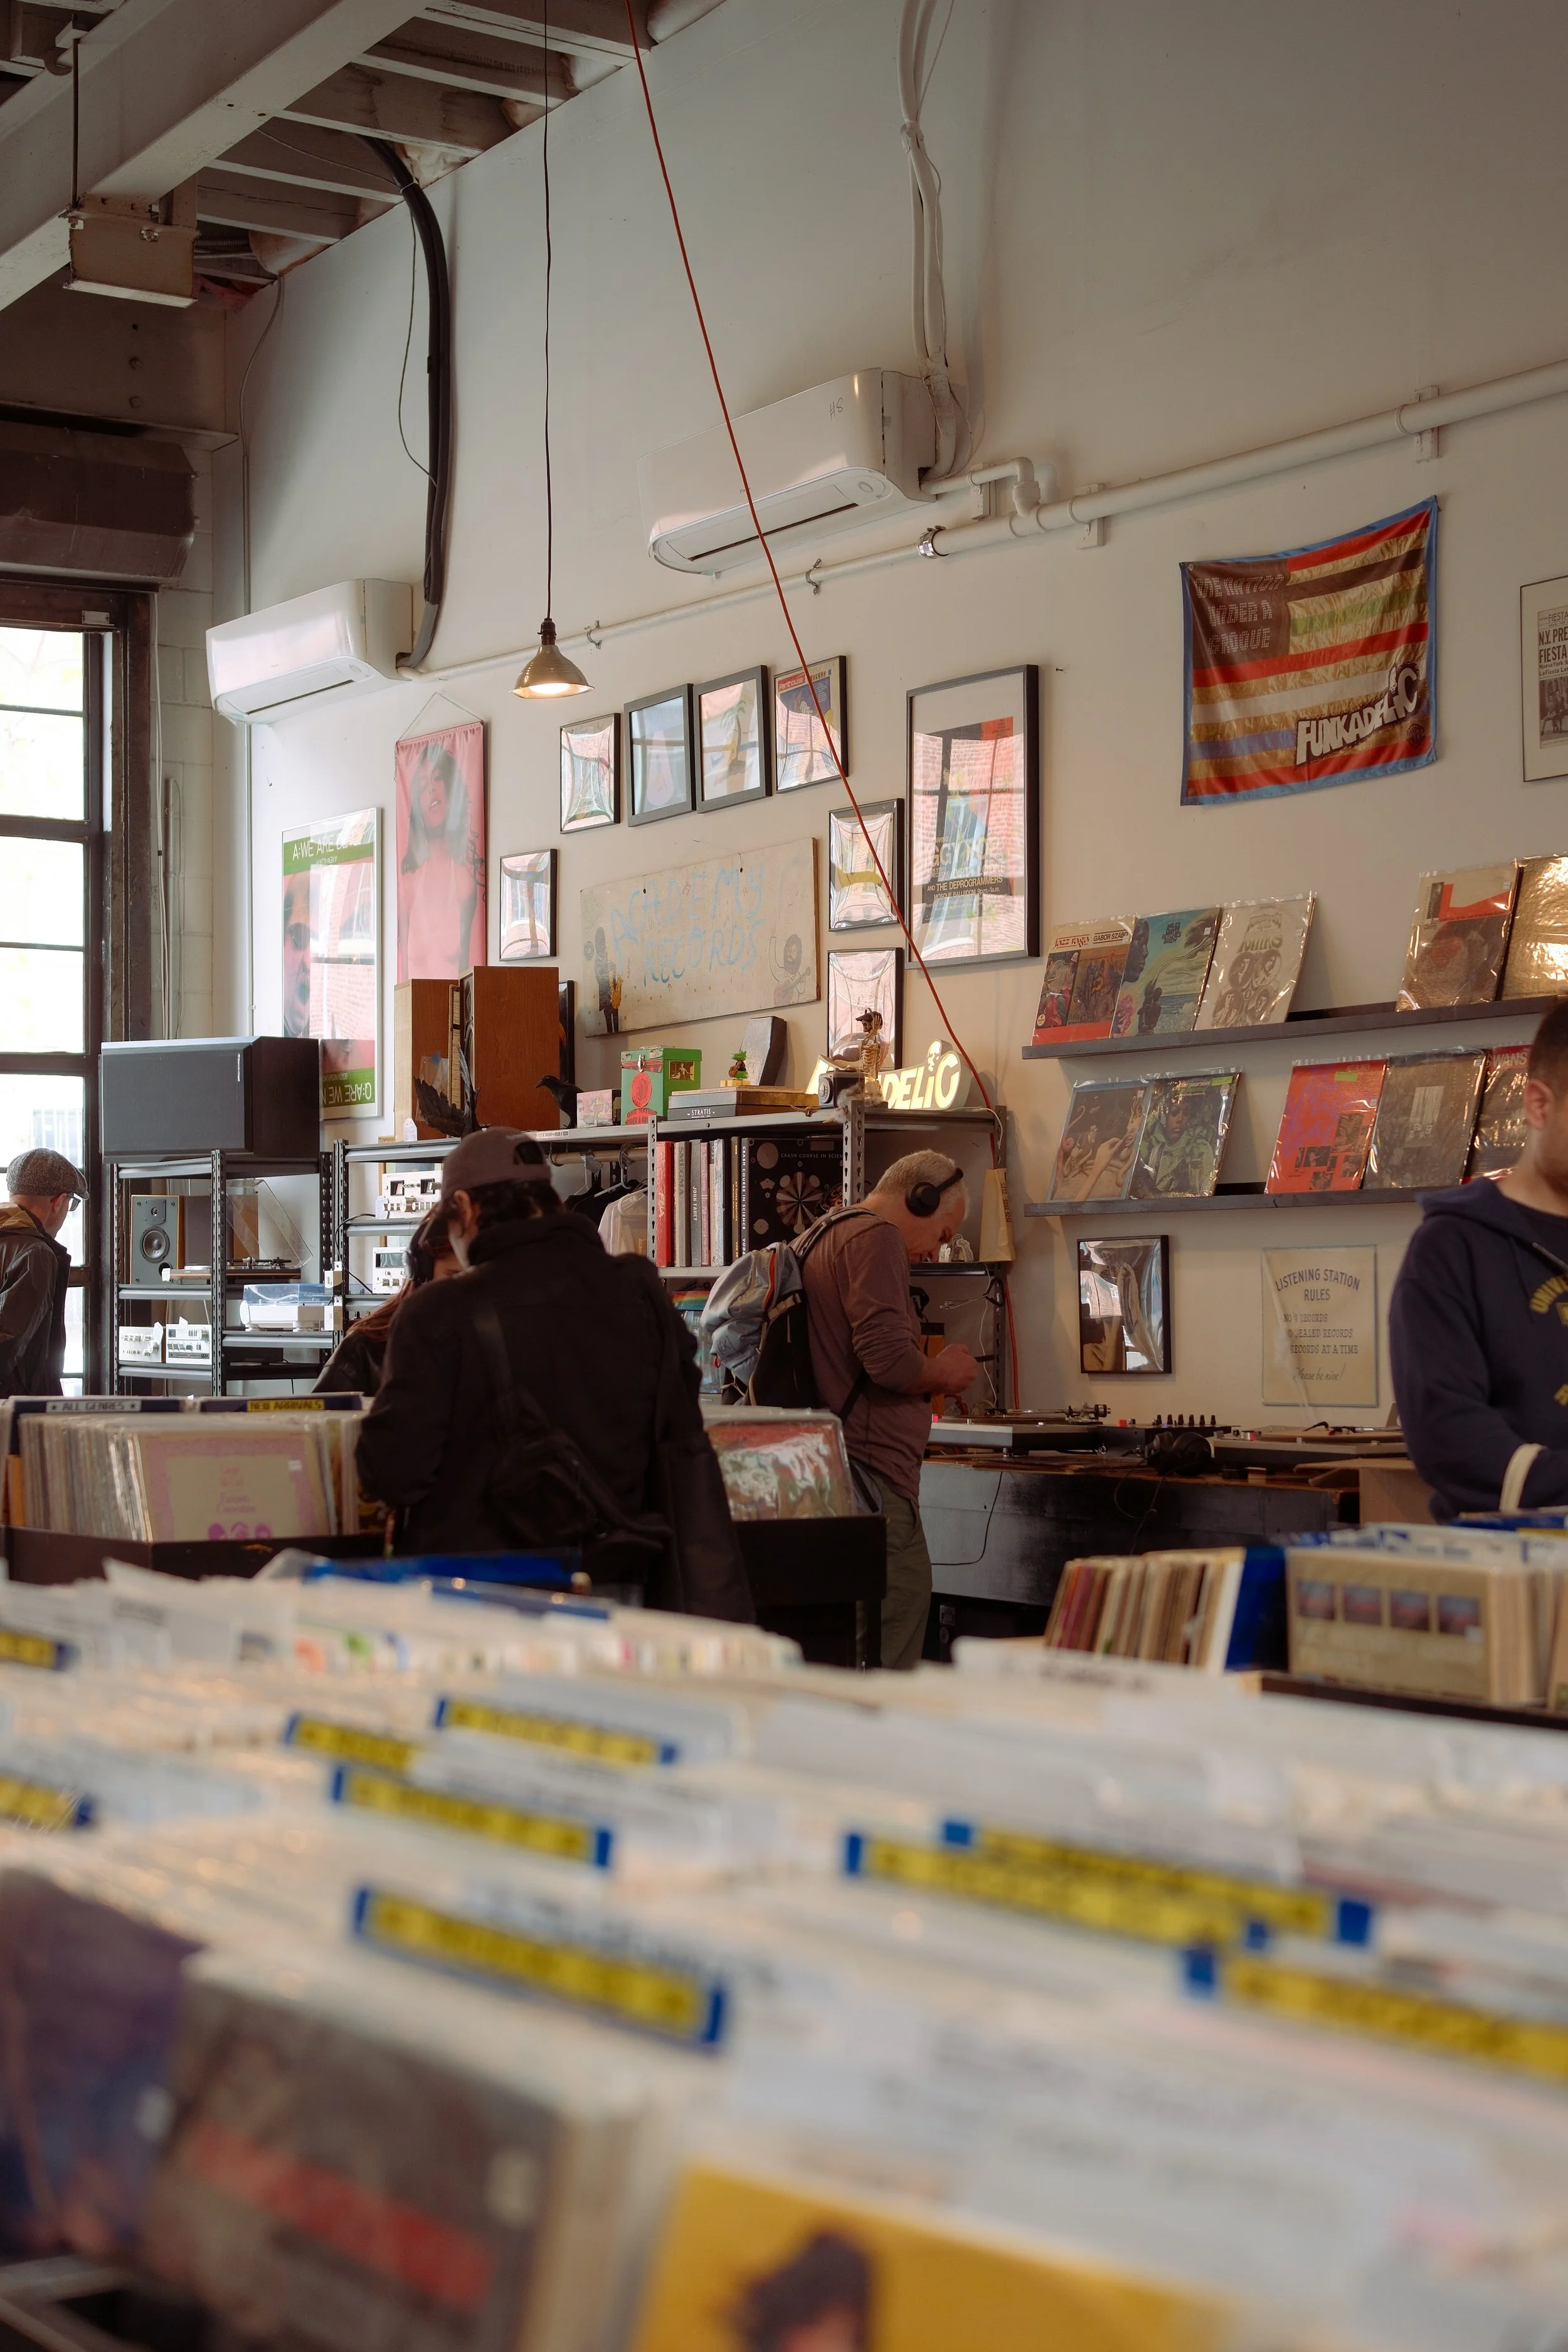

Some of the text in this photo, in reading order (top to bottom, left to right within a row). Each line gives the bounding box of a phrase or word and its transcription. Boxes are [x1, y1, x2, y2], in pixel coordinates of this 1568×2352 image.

[829, 397, 844, 421] #8
[1261, 600, 1273, 620] A
[1539, 644, 1567, 664] FIESTA
[779, 677, 803, 691] Penthouse
[1296, 666, 1418, 766] FUNKADELIC
[936, 882, 948, 892] THE
[949, 876, 1003, 889] DEPROGRAMMERS
[611, 863, 765, 969] ACADEMY
[644, 918, 766, 987] RECORDS
[329, 1085, 343, 1104] WE
[1275, 1268, 1360, 1292] LISTENING STATION
[1304, 1288, 1331, 1301] RULES
[1283, 1313, 1292, 1323] NO
[1323, 1328, 1353, 1338] RECORDS
[1290, 1345, 1359, 1354] RECORDS AT A TIME
[1315, 1367, 1323, 1380] be
[1324, 1362, 1347, 1380] nice!
[61, 1401, 125, 1411] ALL GENRES
[250, 1399, 322, 1411] NEW ARRIVALS
